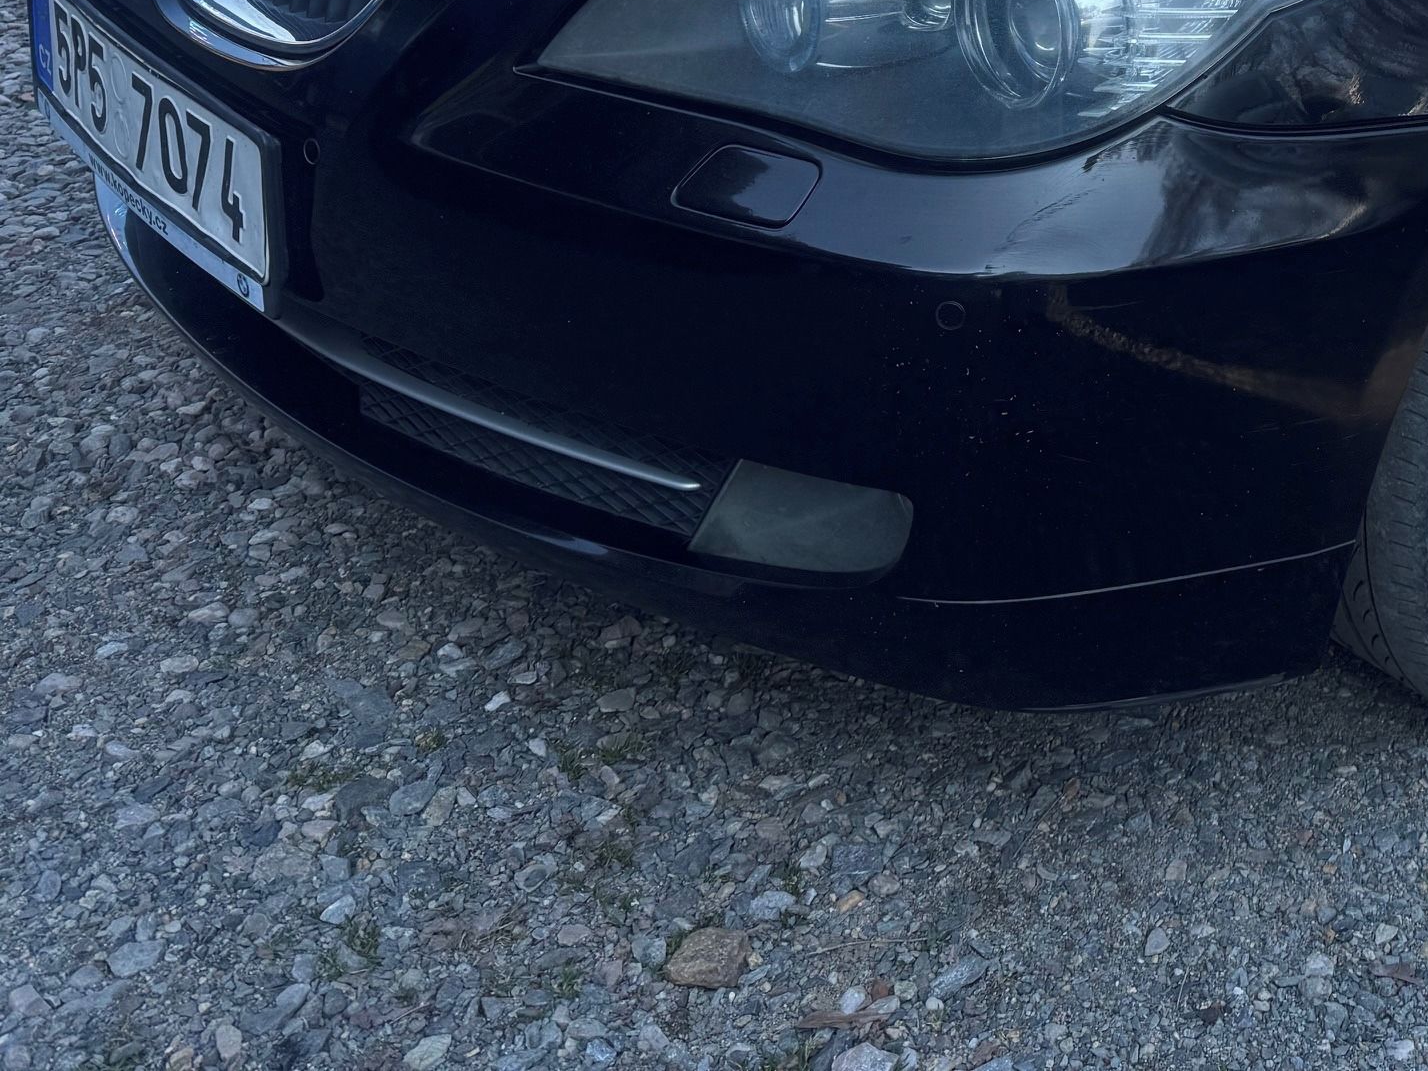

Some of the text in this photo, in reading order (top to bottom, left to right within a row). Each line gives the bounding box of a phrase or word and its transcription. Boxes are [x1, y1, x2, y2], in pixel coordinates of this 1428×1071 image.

[39, 44, 51, 76] CZ
[54, 0, 246, 244] 5P5 7074
[88, 153, 169, 236] www.kopecky.cz
